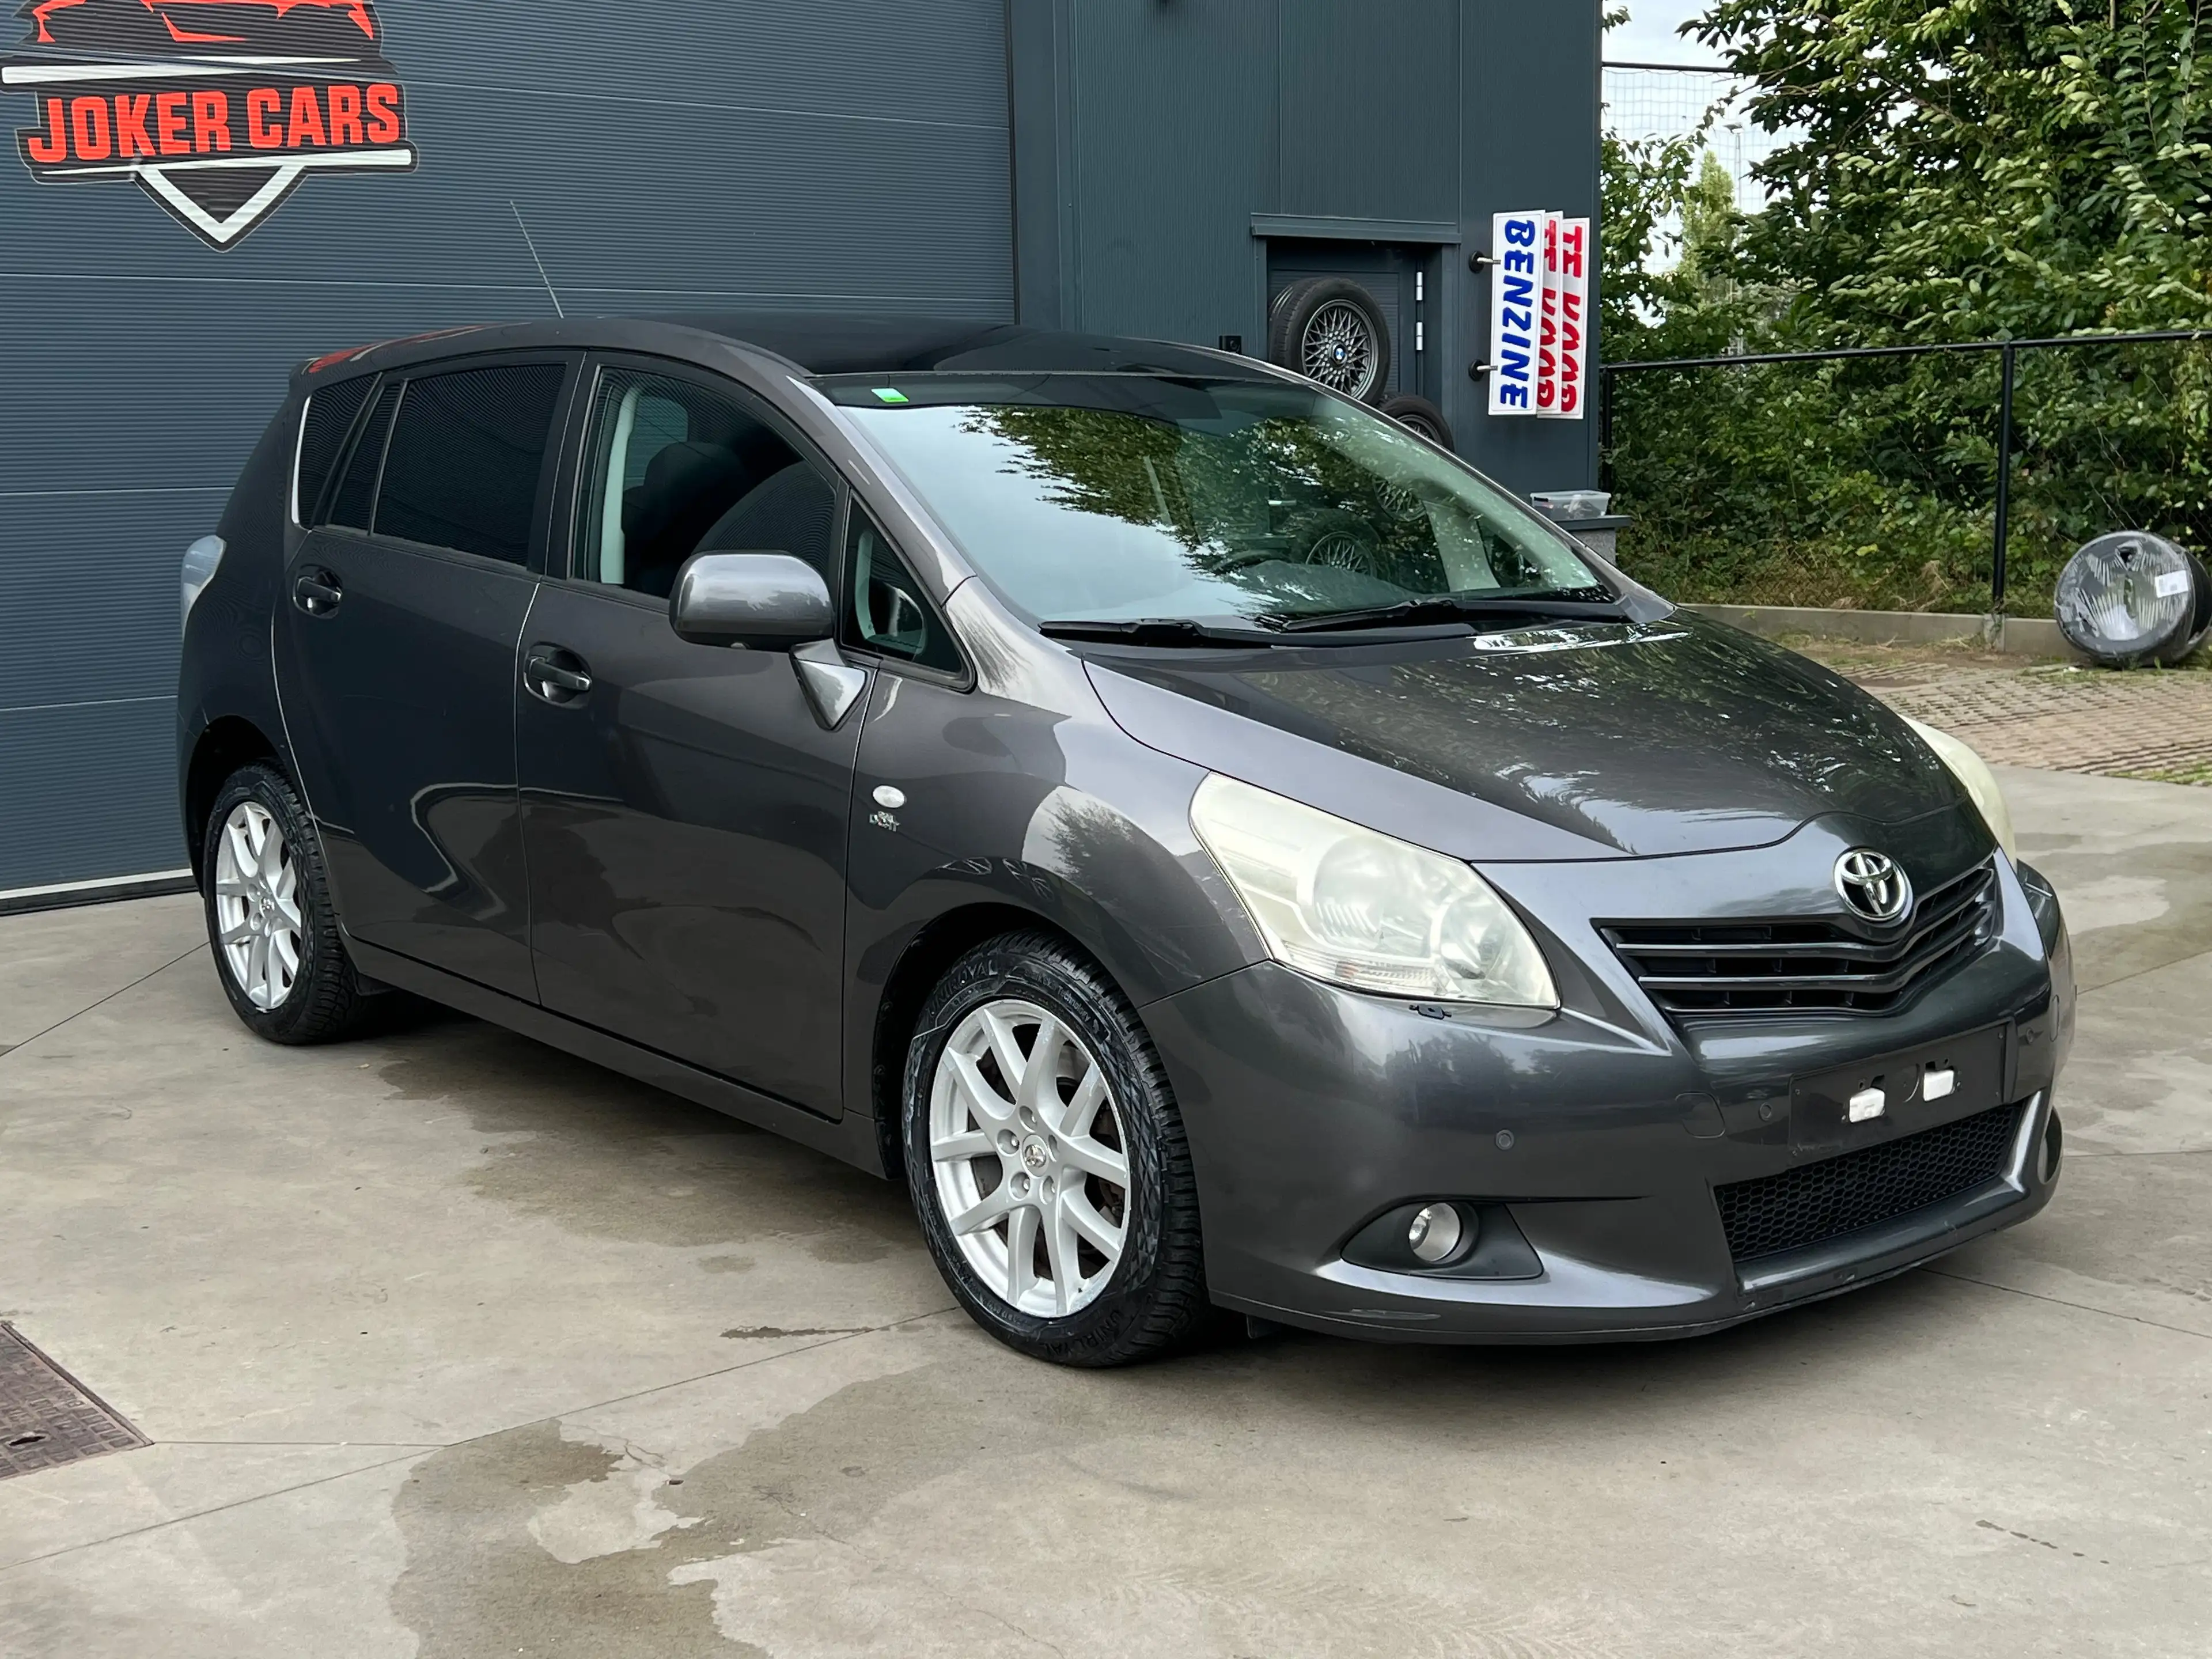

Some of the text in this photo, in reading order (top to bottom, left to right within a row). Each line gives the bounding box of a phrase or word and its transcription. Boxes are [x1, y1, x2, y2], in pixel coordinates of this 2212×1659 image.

[28, 84, 399, 162] JOKER CARS
[1500, 219, 1535, 408] BENZINE
